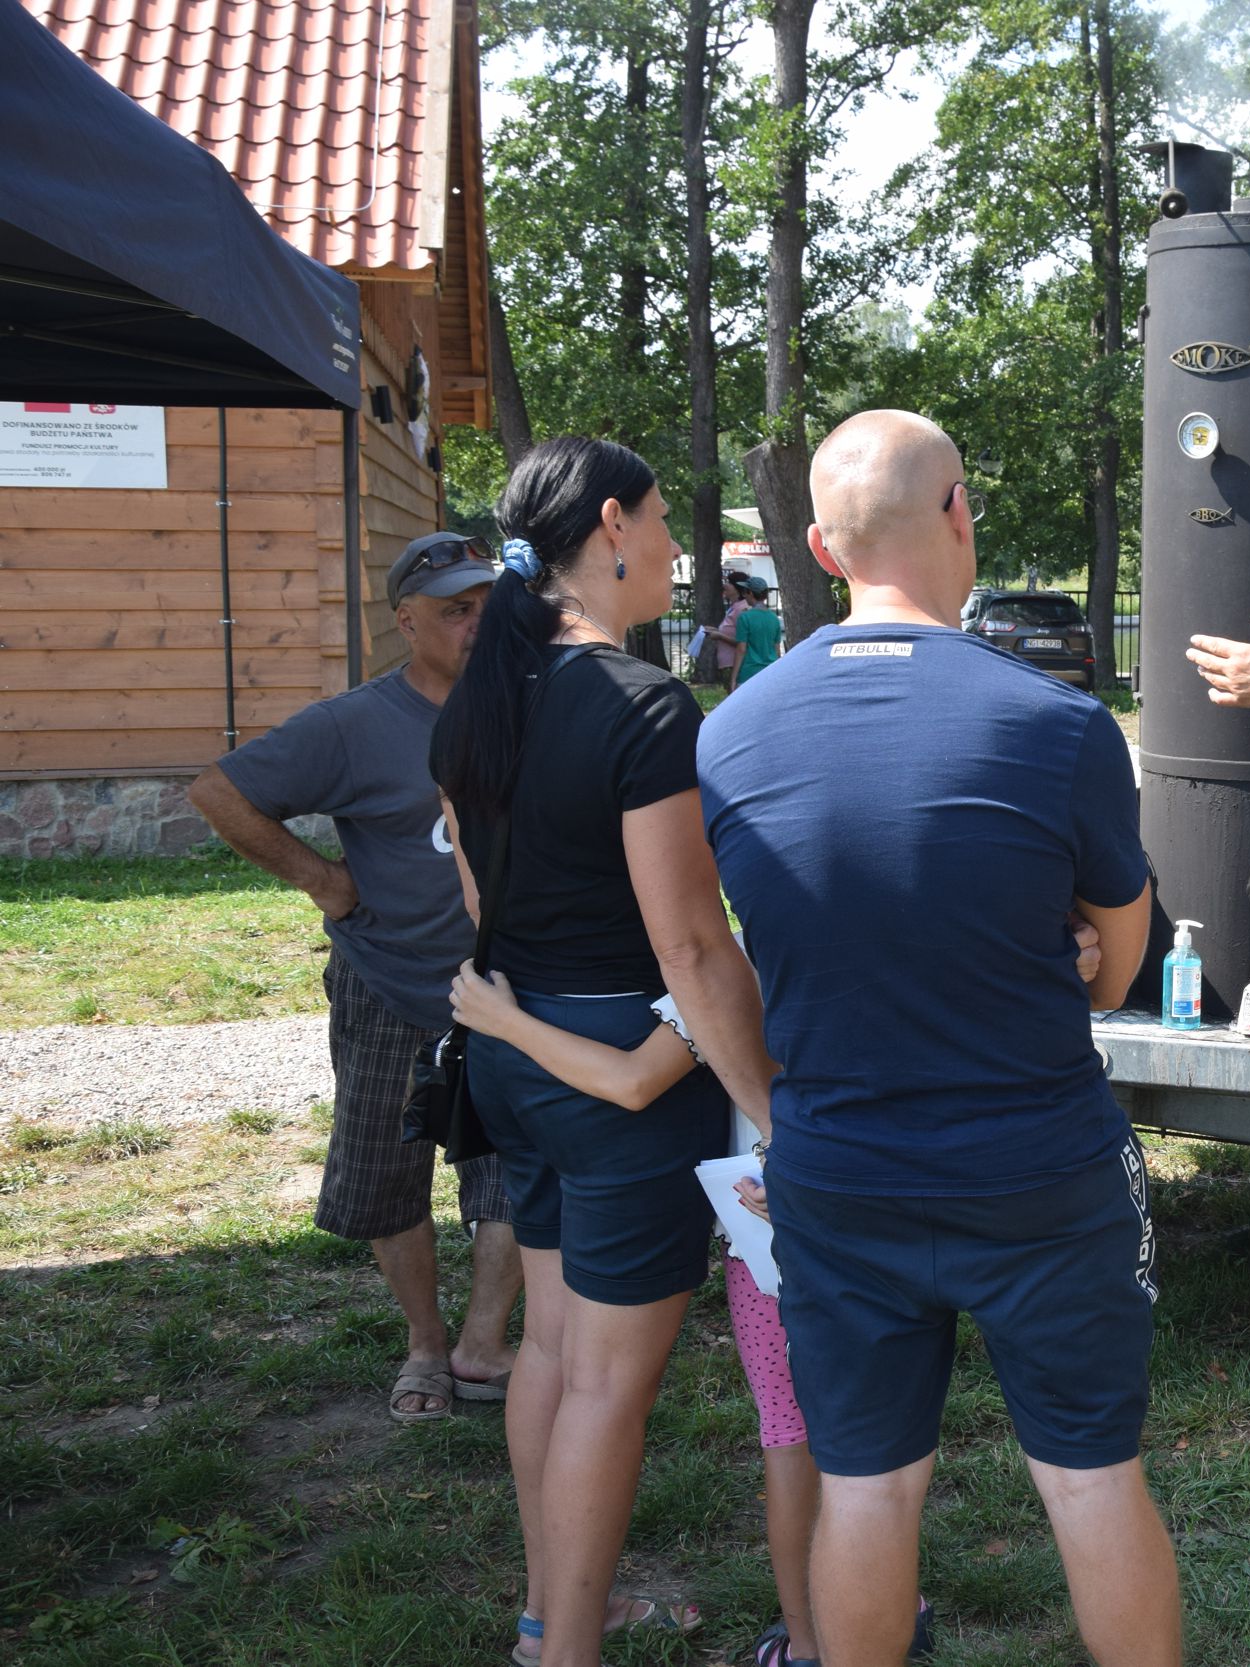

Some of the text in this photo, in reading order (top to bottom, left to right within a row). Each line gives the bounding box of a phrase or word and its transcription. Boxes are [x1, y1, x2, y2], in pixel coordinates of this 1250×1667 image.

[1177, 344, 1244, 370] SMOKE
[2, 421, 82, 430] DOFINANSOWANO
[95, 421, 139, 431] ŚRODKÓW
[737, 544, 770, 553] ORLEN
[834, 643, 891, 654] PITBULL
